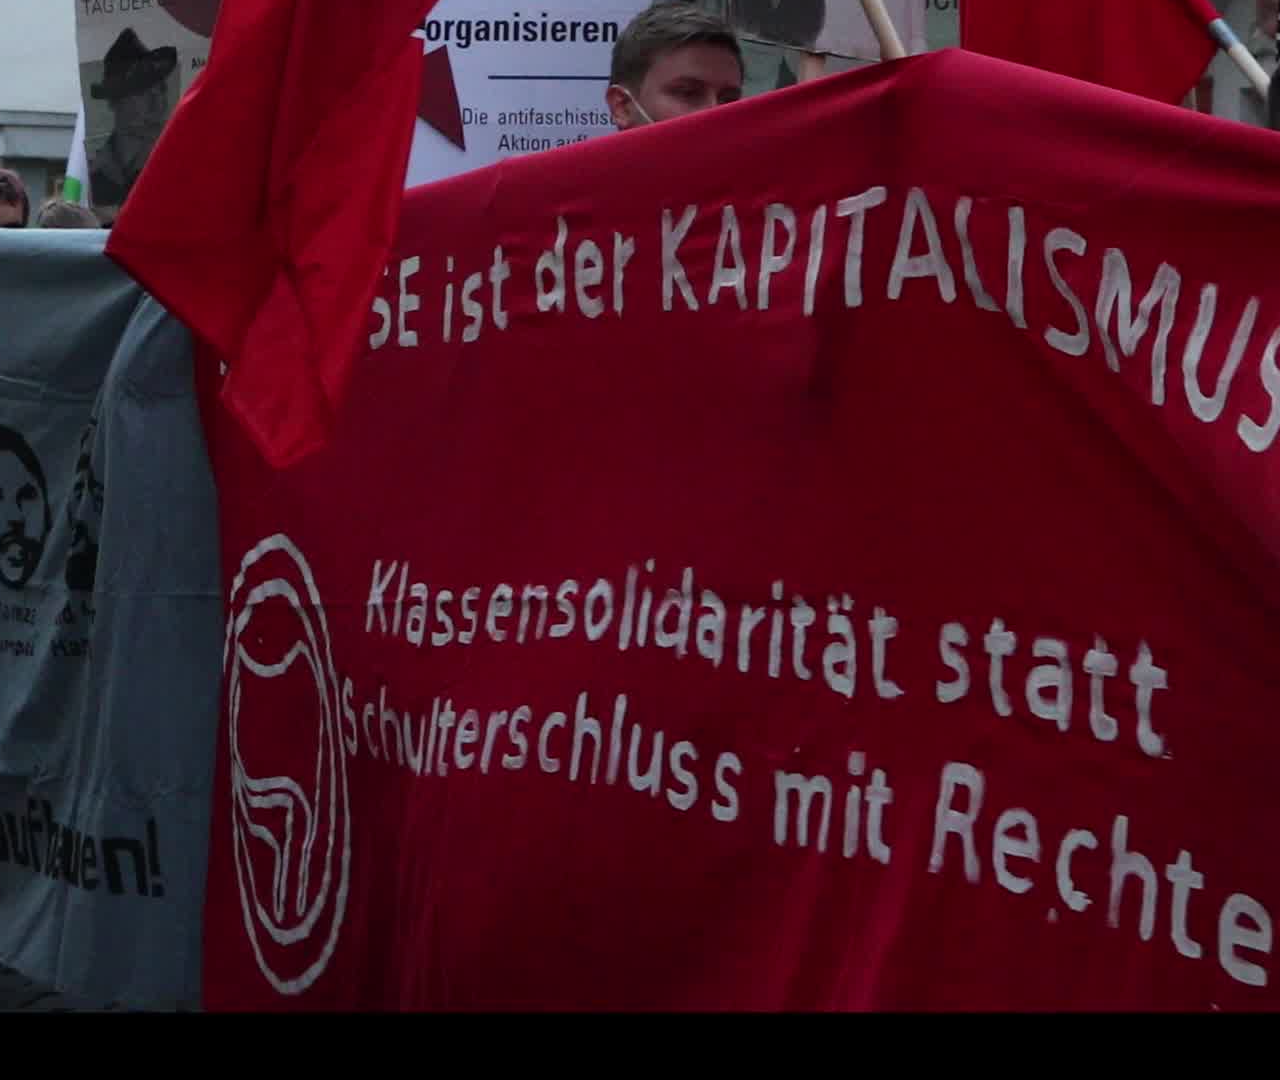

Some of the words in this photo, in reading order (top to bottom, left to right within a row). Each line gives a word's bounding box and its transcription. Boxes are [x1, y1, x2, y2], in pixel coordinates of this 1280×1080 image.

[425, 12, 619, 48] organisieren
[462, 108, 488, 125] Die
[498, 134, 551, 151] Aktion
[442, 244, 511, 344] ist
[534, 216, 636, 319] der
[365, 557, 905, 701] Klassensolidarität
[935, 616, 1173, 760] statt
[340, 676, 744, 823] Schulterschluss
[773, 750, 894, 865] mit
